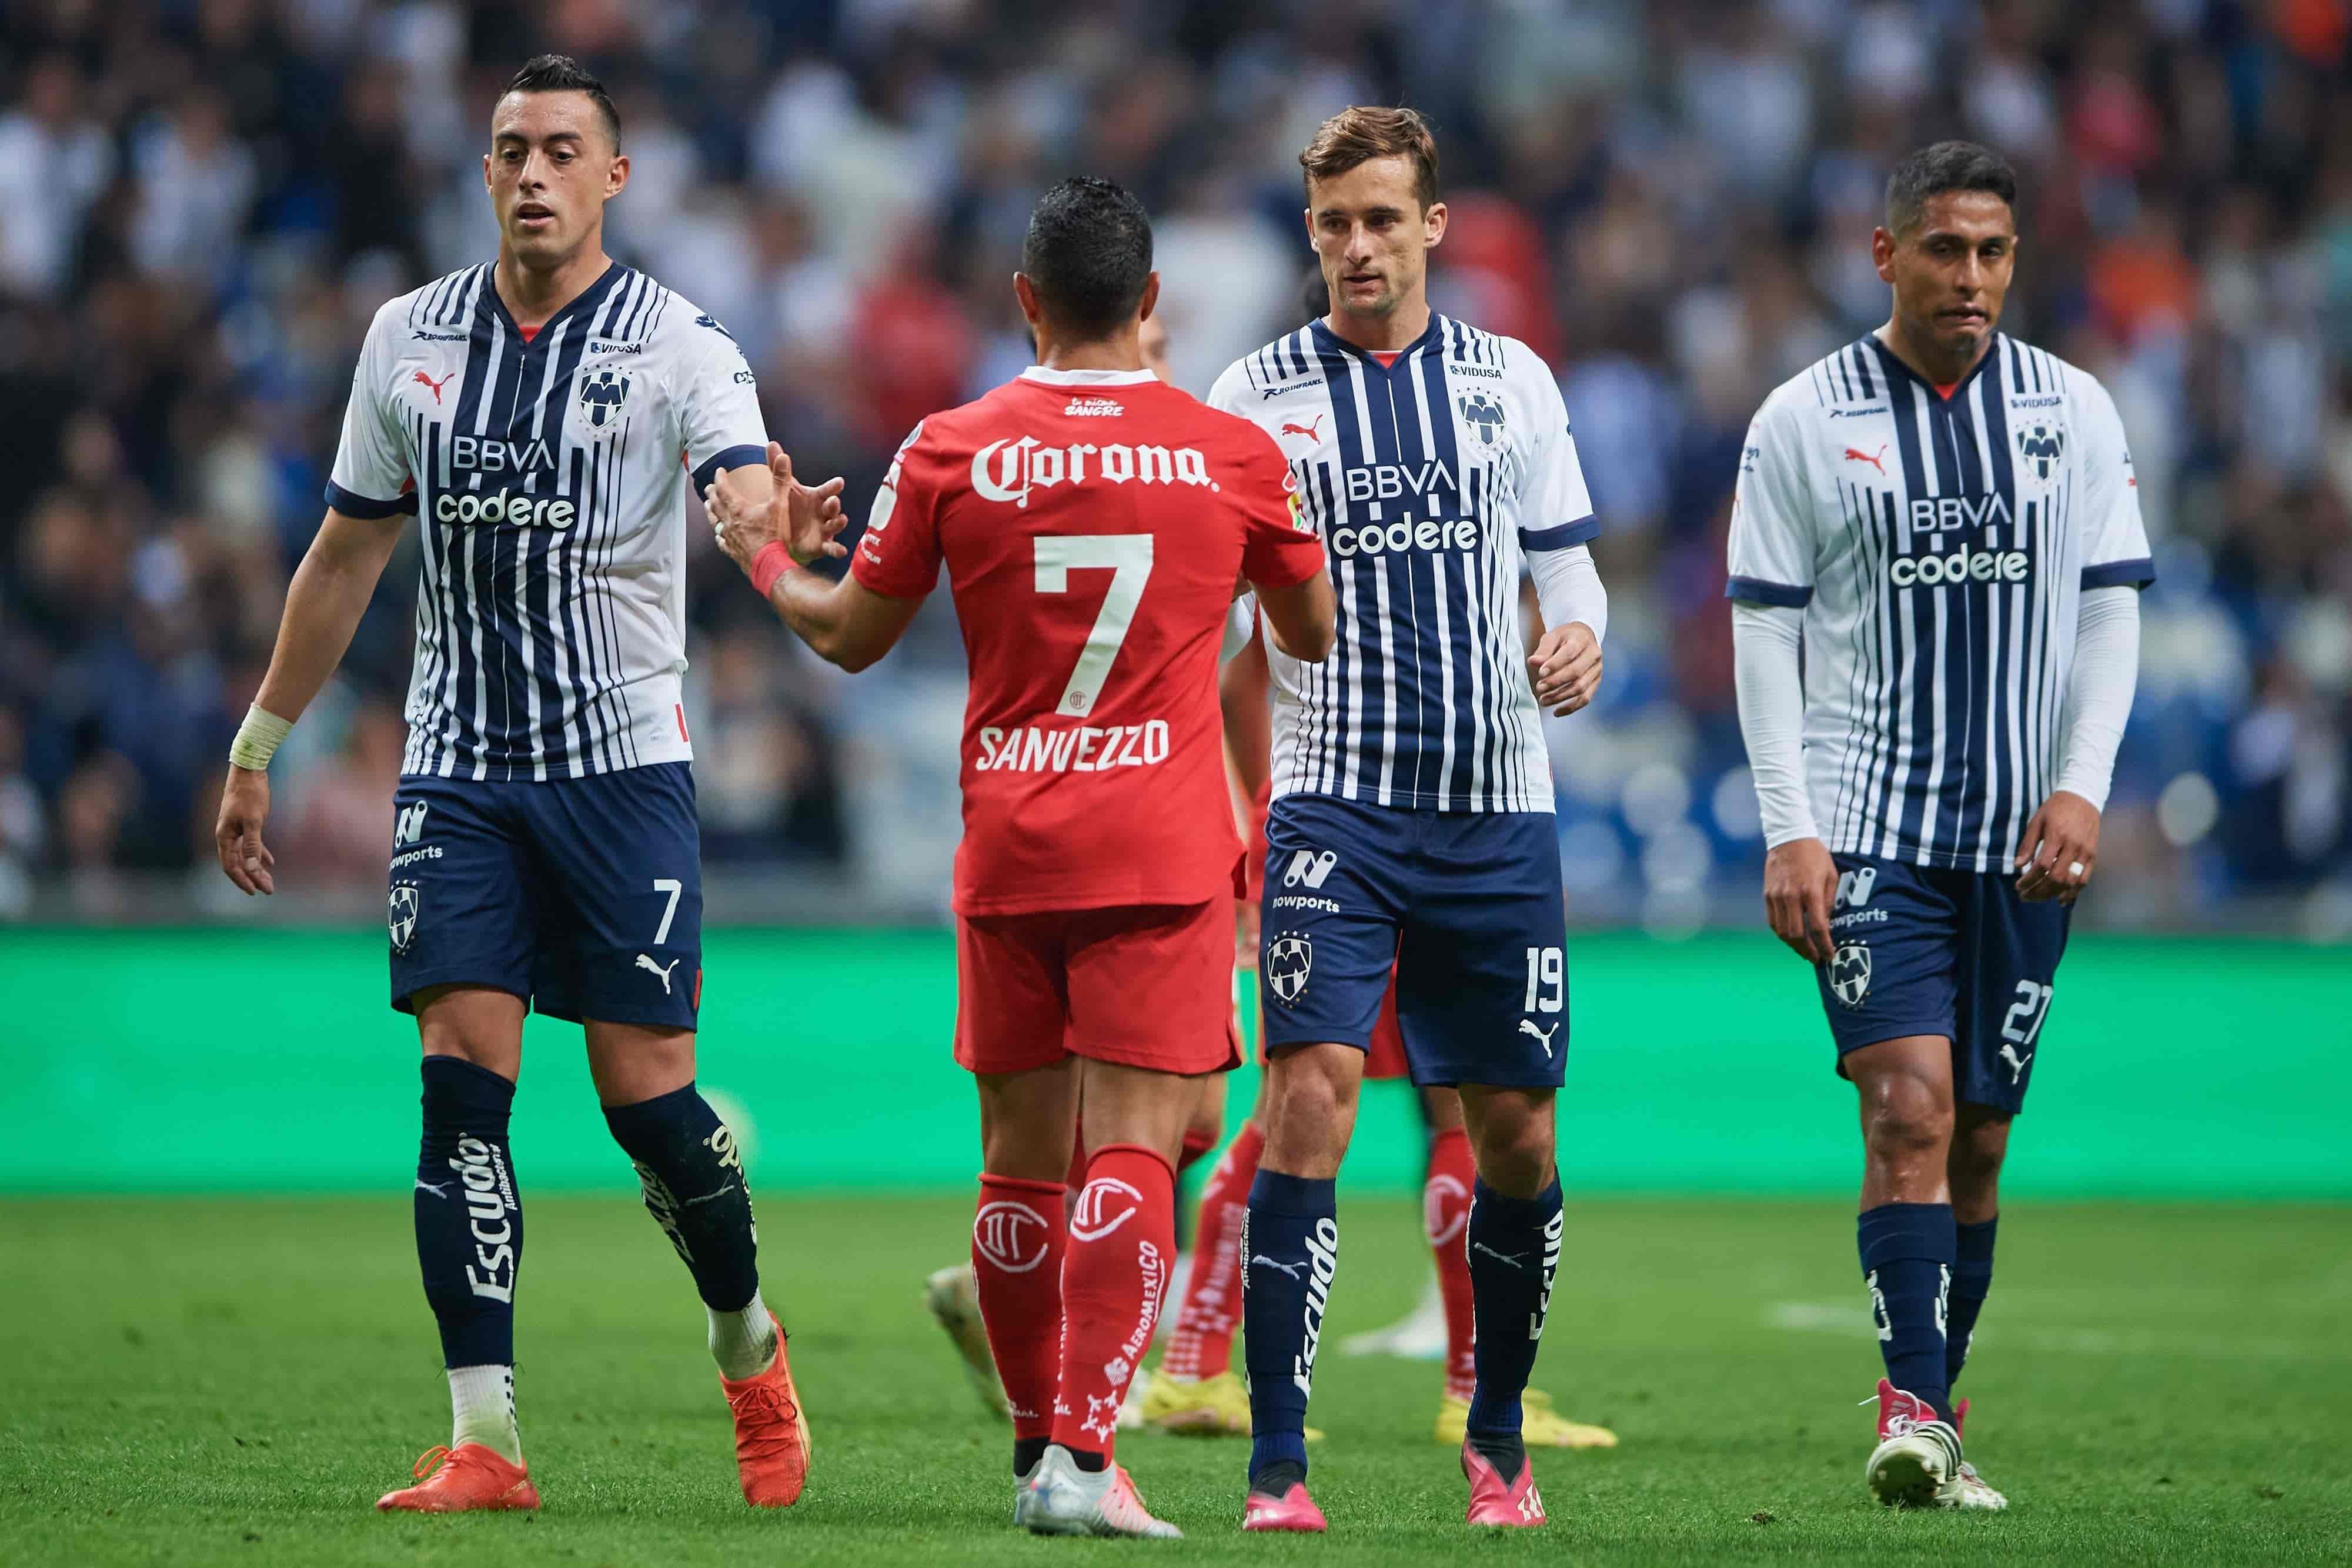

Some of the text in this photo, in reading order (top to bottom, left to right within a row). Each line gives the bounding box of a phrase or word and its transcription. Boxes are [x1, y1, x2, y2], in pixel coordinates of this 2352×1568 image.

[1461, 366, 1502, 379] VIDUSA
[1064, 406, 1125, 416] SANGRE
[2021, 396, 2062, 408] VIDUSA
[453, 435, 556, 473] BBVA
[1347, 458, 1456, 502] BBVA
[436, 487, 575, 530] codere
[1910, 492, 2013, 532] BBVA
[1332, 512, 1478, 557] codere
[1890, 543, 2029, 586] codere
[1034, 534, 1154, 718] 7
[975, 719, 1170, 773] SANVEZZO
[389, 846, 443, 872] owports
[653, 879, 682, 945] 7
[1829, 908, 1889, 929] owports
[1524, 947, 1563, 1013] 19
[2001, 979, 2054, 1045] 21
[449, 1138, 513, 1304] Escudo
[1294, 1217, 1338, 1402] Escudo
